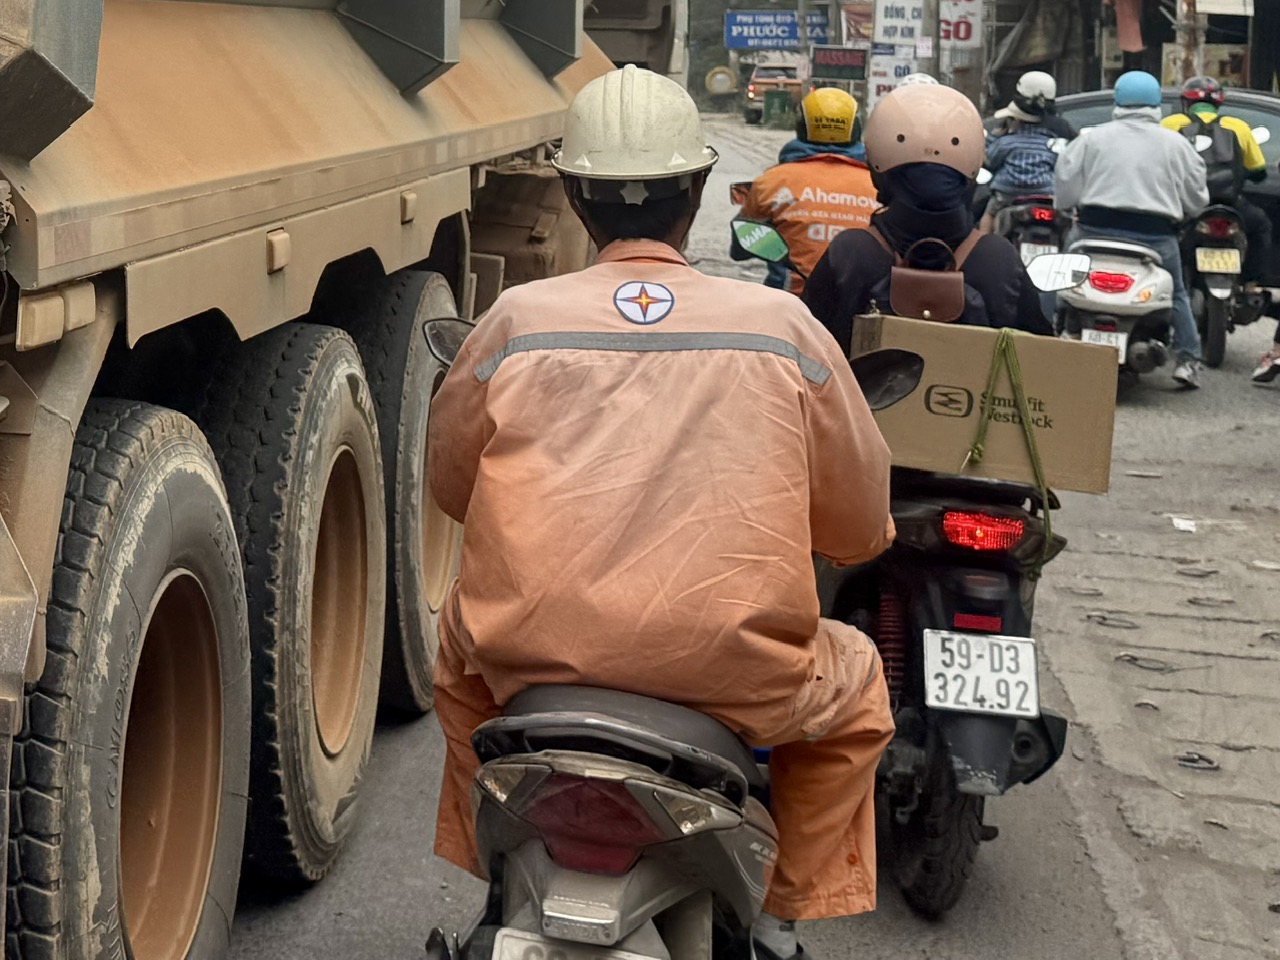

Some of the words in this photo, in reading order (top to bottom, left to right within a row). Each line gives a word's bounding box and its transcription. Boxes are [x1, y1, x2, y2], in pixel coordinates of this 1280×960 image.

[800, 186, 884, 210] Ahamov
[980, 391, 1045, 412] Smuit
[940, 637, 1020, 674] 59-D3
[933, 672, 1031, 712] 324.92
